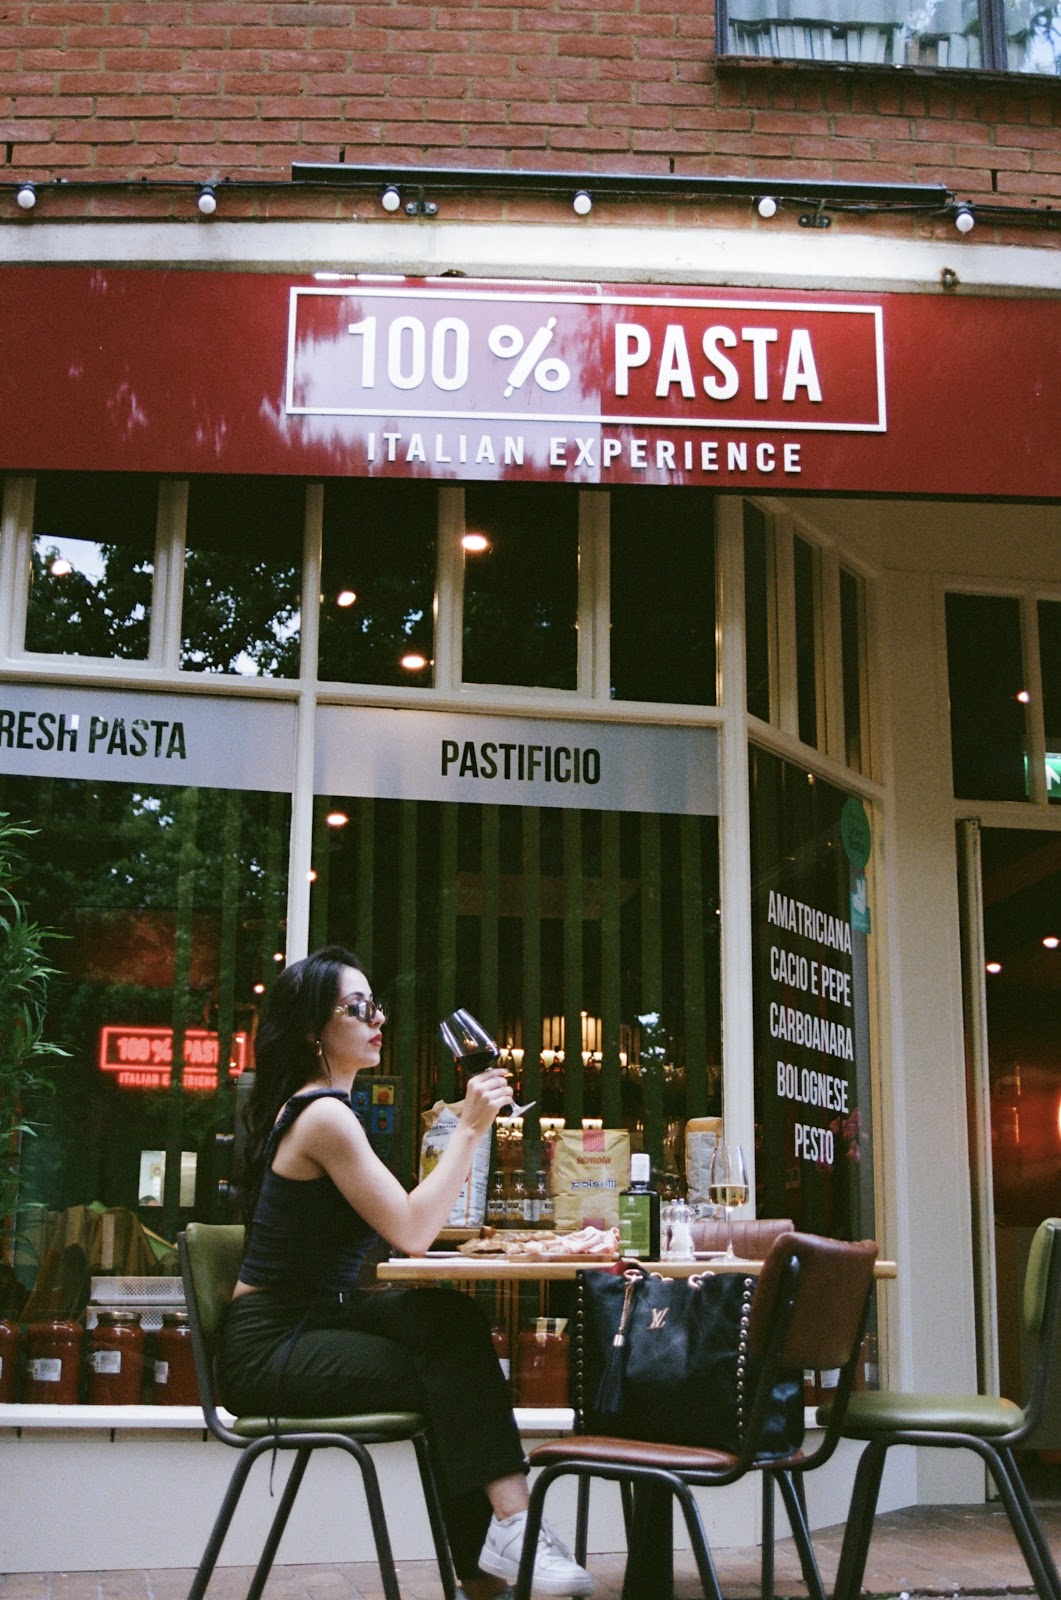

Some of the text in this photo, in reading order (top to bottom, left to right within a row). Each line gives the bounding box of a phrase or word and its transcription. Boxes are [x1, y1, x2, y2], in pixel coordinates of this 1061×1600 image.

[348, 316, 822, 402] 100 % PASTA
[368, 432, 801, 473] ITALIAN EXPERIENCE
[88, 716, 187, 759] PASTA
[441, 740, 600, 785] PASTIFICIO
[768, 890, 852, 955] AMATRICIANA
[770, 946, 851, 1007] CACIO E PEPE
[117, 1037, 150, 1061] 100
[770, 1002, 853, 1061] CARBOANARA
[777, 1061, 848, 1114] BOLOGNESE
[795, 1123, 834, 1165] PESTO
